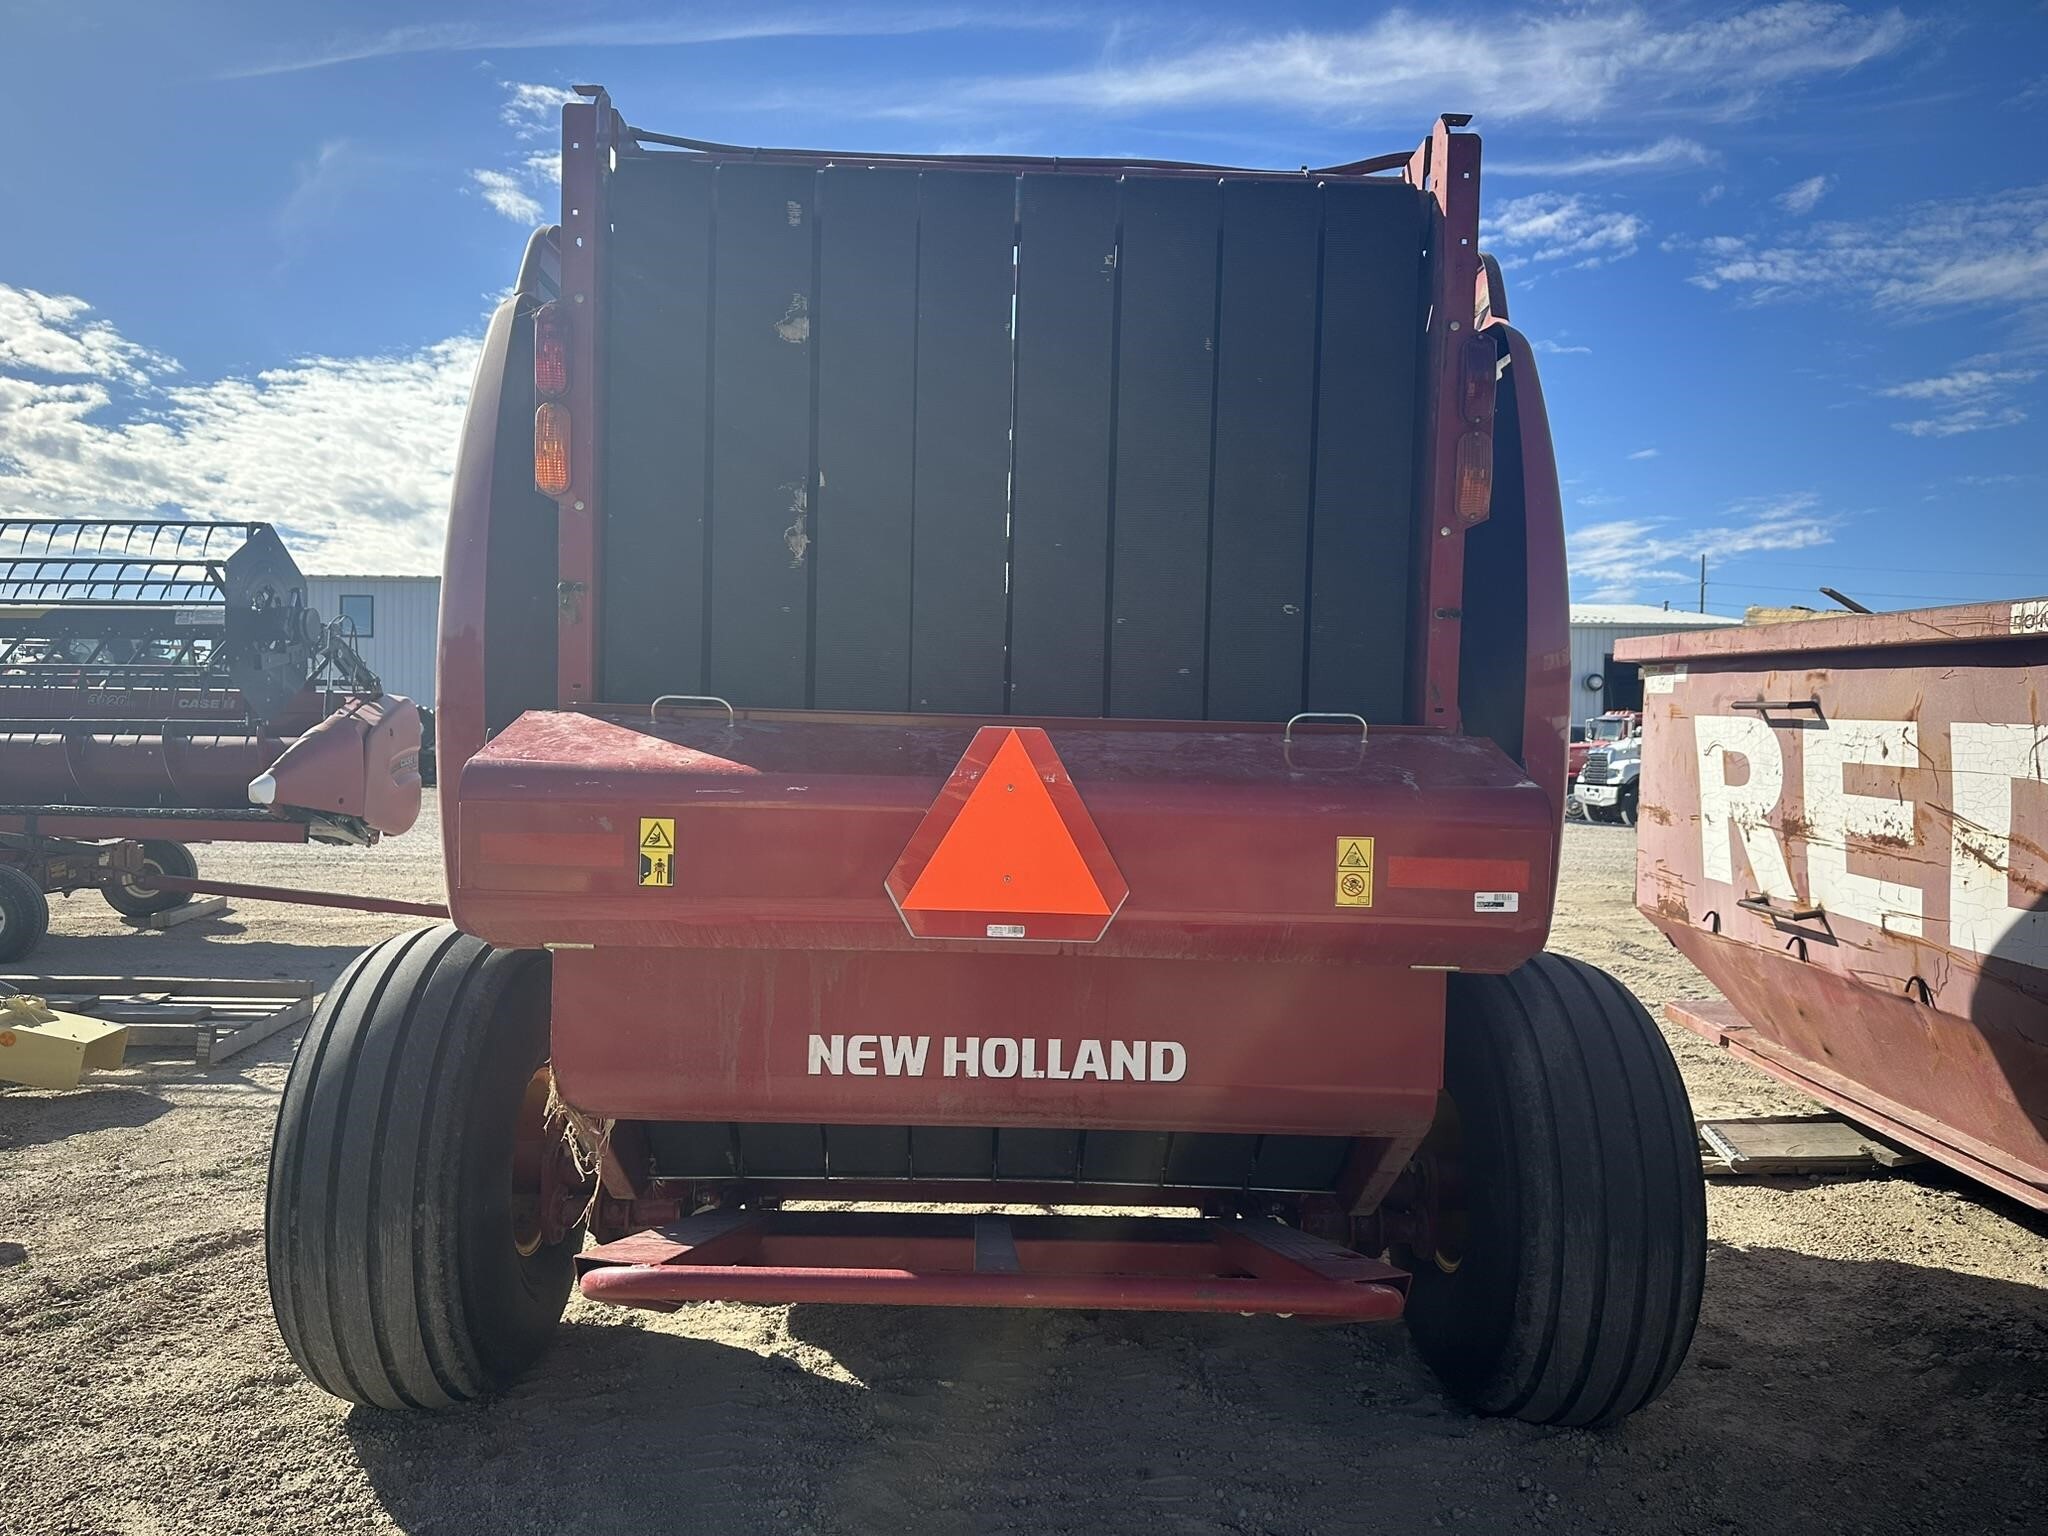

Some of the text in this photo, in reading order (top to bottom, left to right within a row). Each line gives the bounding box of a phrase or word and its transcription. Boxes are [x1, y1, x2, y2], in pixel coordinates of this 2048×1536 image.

[178, 698, 220, 709] CASE
[808, 1034, 1187, 1082] NEW HOLLAND
